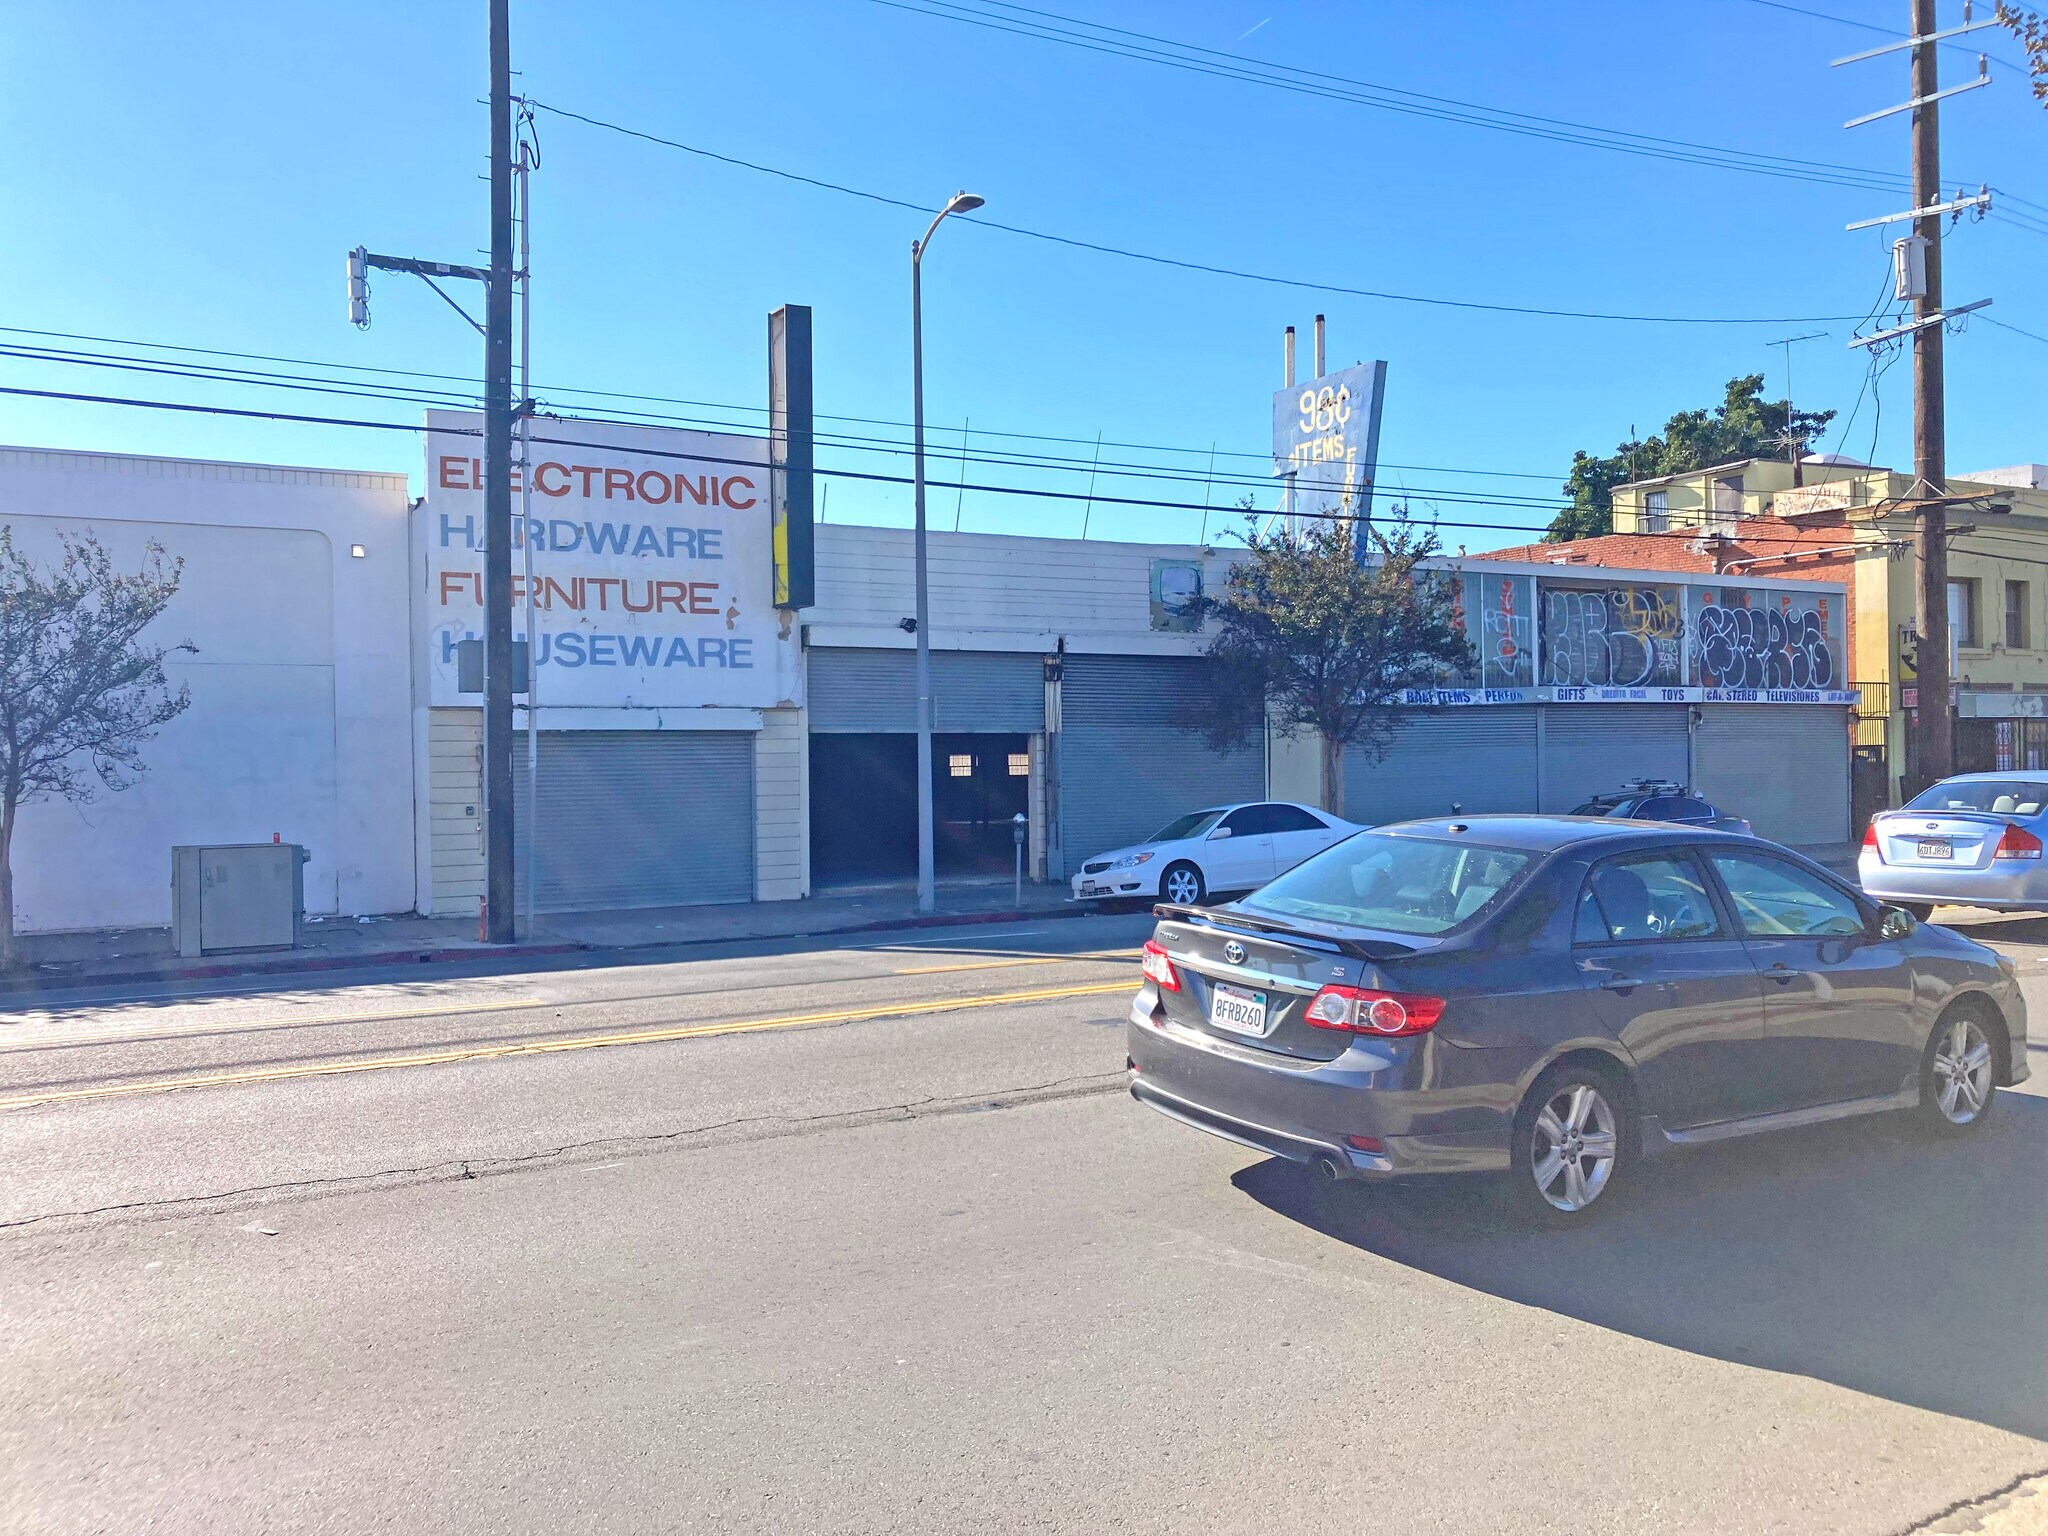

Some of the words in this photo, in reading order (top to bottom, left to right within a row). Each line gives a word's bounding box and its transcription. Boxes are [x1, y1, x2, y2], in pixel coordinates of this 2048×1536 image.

[1294, 434, 1345, 469] ITEMS
[440, 513, 724, 560] HRDWARE
[441, 629, 754, 669] HUSEWARE
[1437, 690, 1471, 703] ITEMS
[1557, 688, 1586, 701] GIFTS
[1661, 689, 1685, 701] TOYS
[1726, 690, 1758, 702] STEREO
[1766, 690, 1820, 702] TELEVISIONES
[1216, 998, 1262, 1027] 8FRB260
